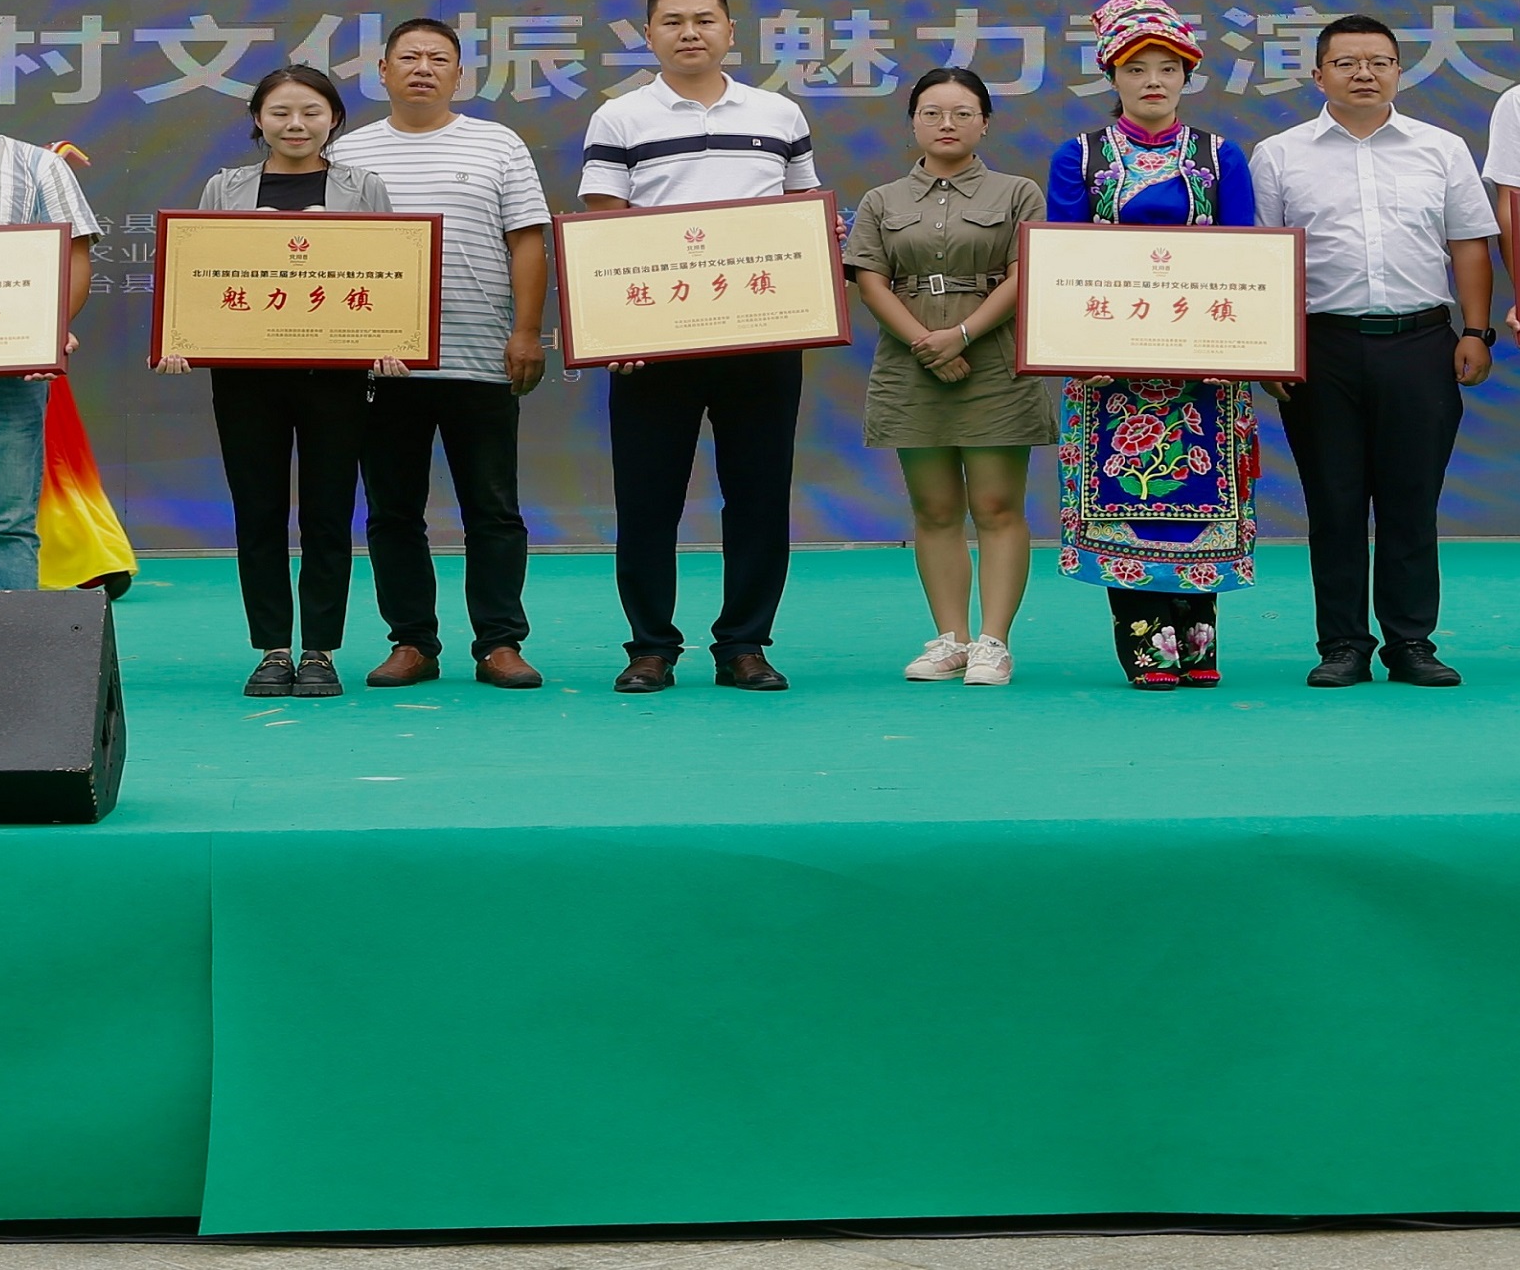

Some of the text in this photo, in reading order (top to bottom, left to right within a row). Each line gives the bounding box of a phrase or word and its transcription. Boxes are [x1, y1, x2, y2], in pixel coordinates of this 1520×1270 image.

[219, 285, 375, 313] 魅力乡镇
[625, 270, 777, 307] 魅力乡镇
[1083, 295, 1238, 324] 魅力乡镇
